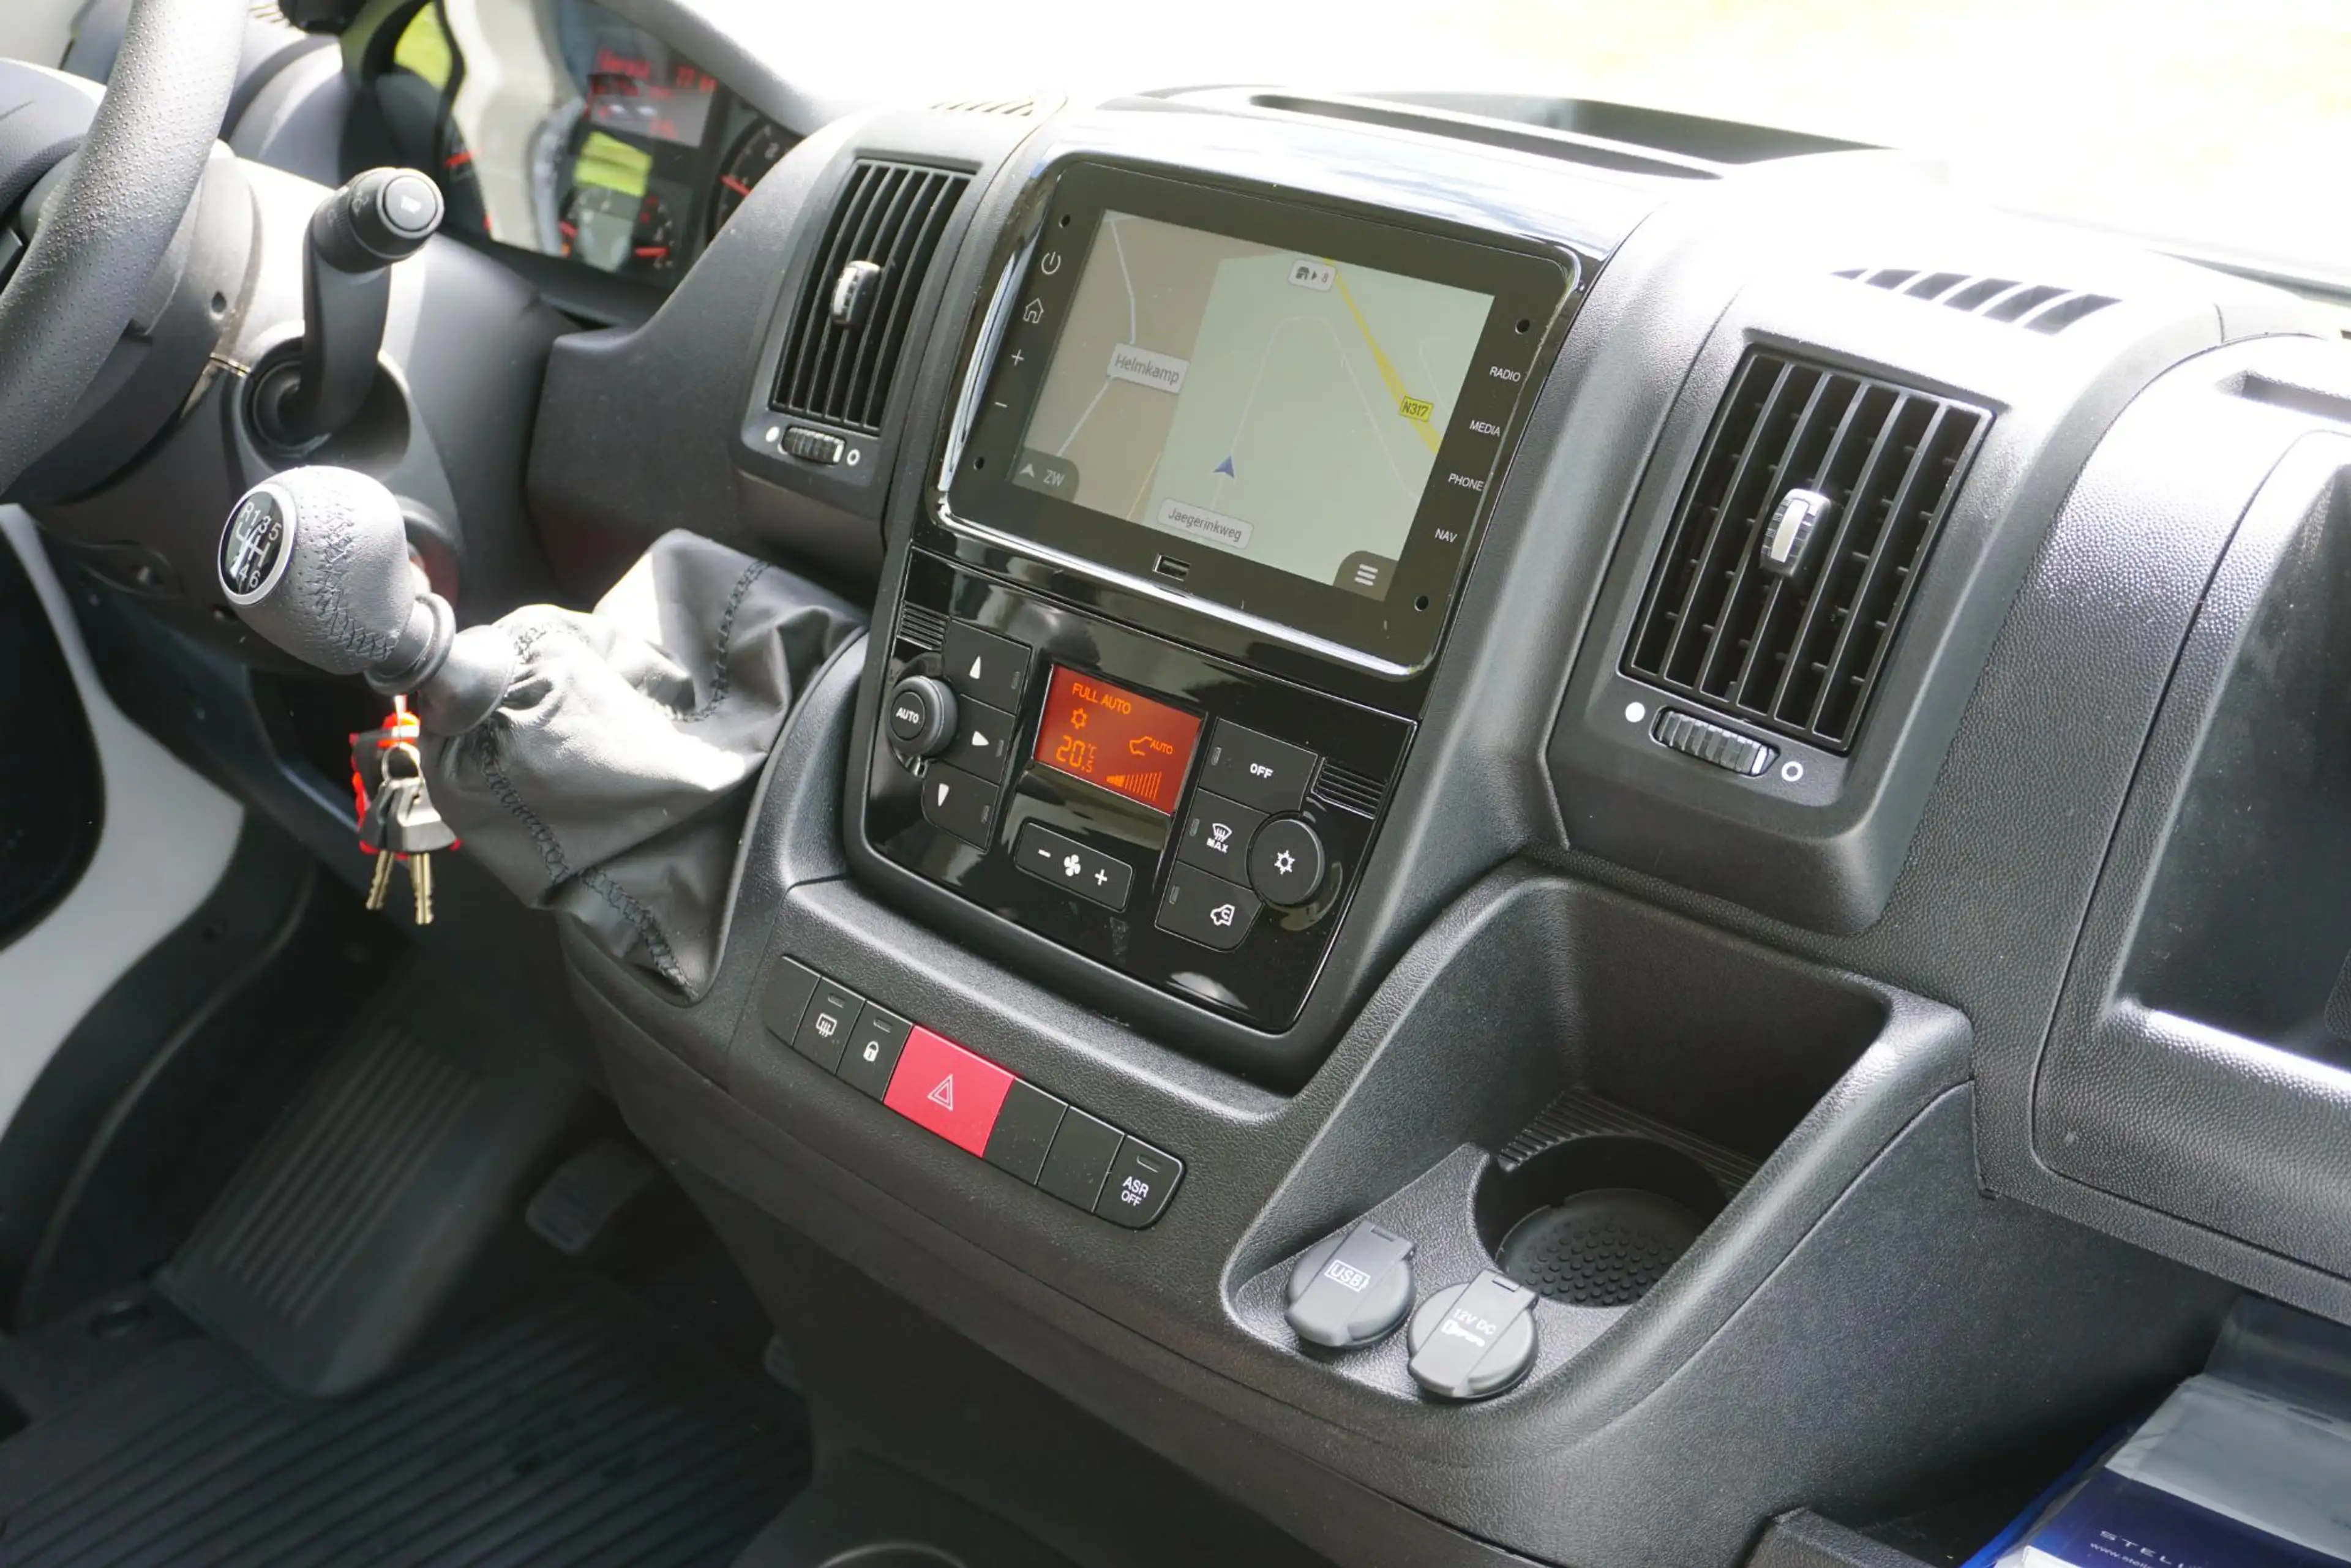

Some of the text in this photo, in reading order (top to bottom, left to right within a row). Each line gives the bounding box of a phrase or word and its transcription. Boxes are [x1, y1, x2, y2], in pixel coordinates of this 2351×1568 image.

[1114, 353, 1180, 386] Helmkamp
[1490, 366, 1521, 382] RADIO
[1401, 401, 1430, 417] N317
[1469, 420, 1501, 437] MEDIA
[1043, 468, 1066, 487] ZW
[1448, 473, 1484, 491] PHONE
[240, 501, 282, 541] R 1 3 5
[1168, 508, 1242, 542] Jaegerinkweg
[1434, 528, 1457, 543] NAV
[239, 563, 250, 581] 4
[249, 570, 261, 589] 6
[1072, 683, 1131, 715] FULL AUTO
[896, 707, 920, 724] AUTO
[1150, 739, 1174, 754] AUTO
[1250, 763, 1274, 778] OFF
[1206, 838, 1229, 853] MAX
[1122, 1176, 1149, 1198] ASR
[1121, 1190, 1142, 1206] OFF
[1330, 1264, 1363, 1286] USB
[1476, 1319, 1496, 1335] DC
